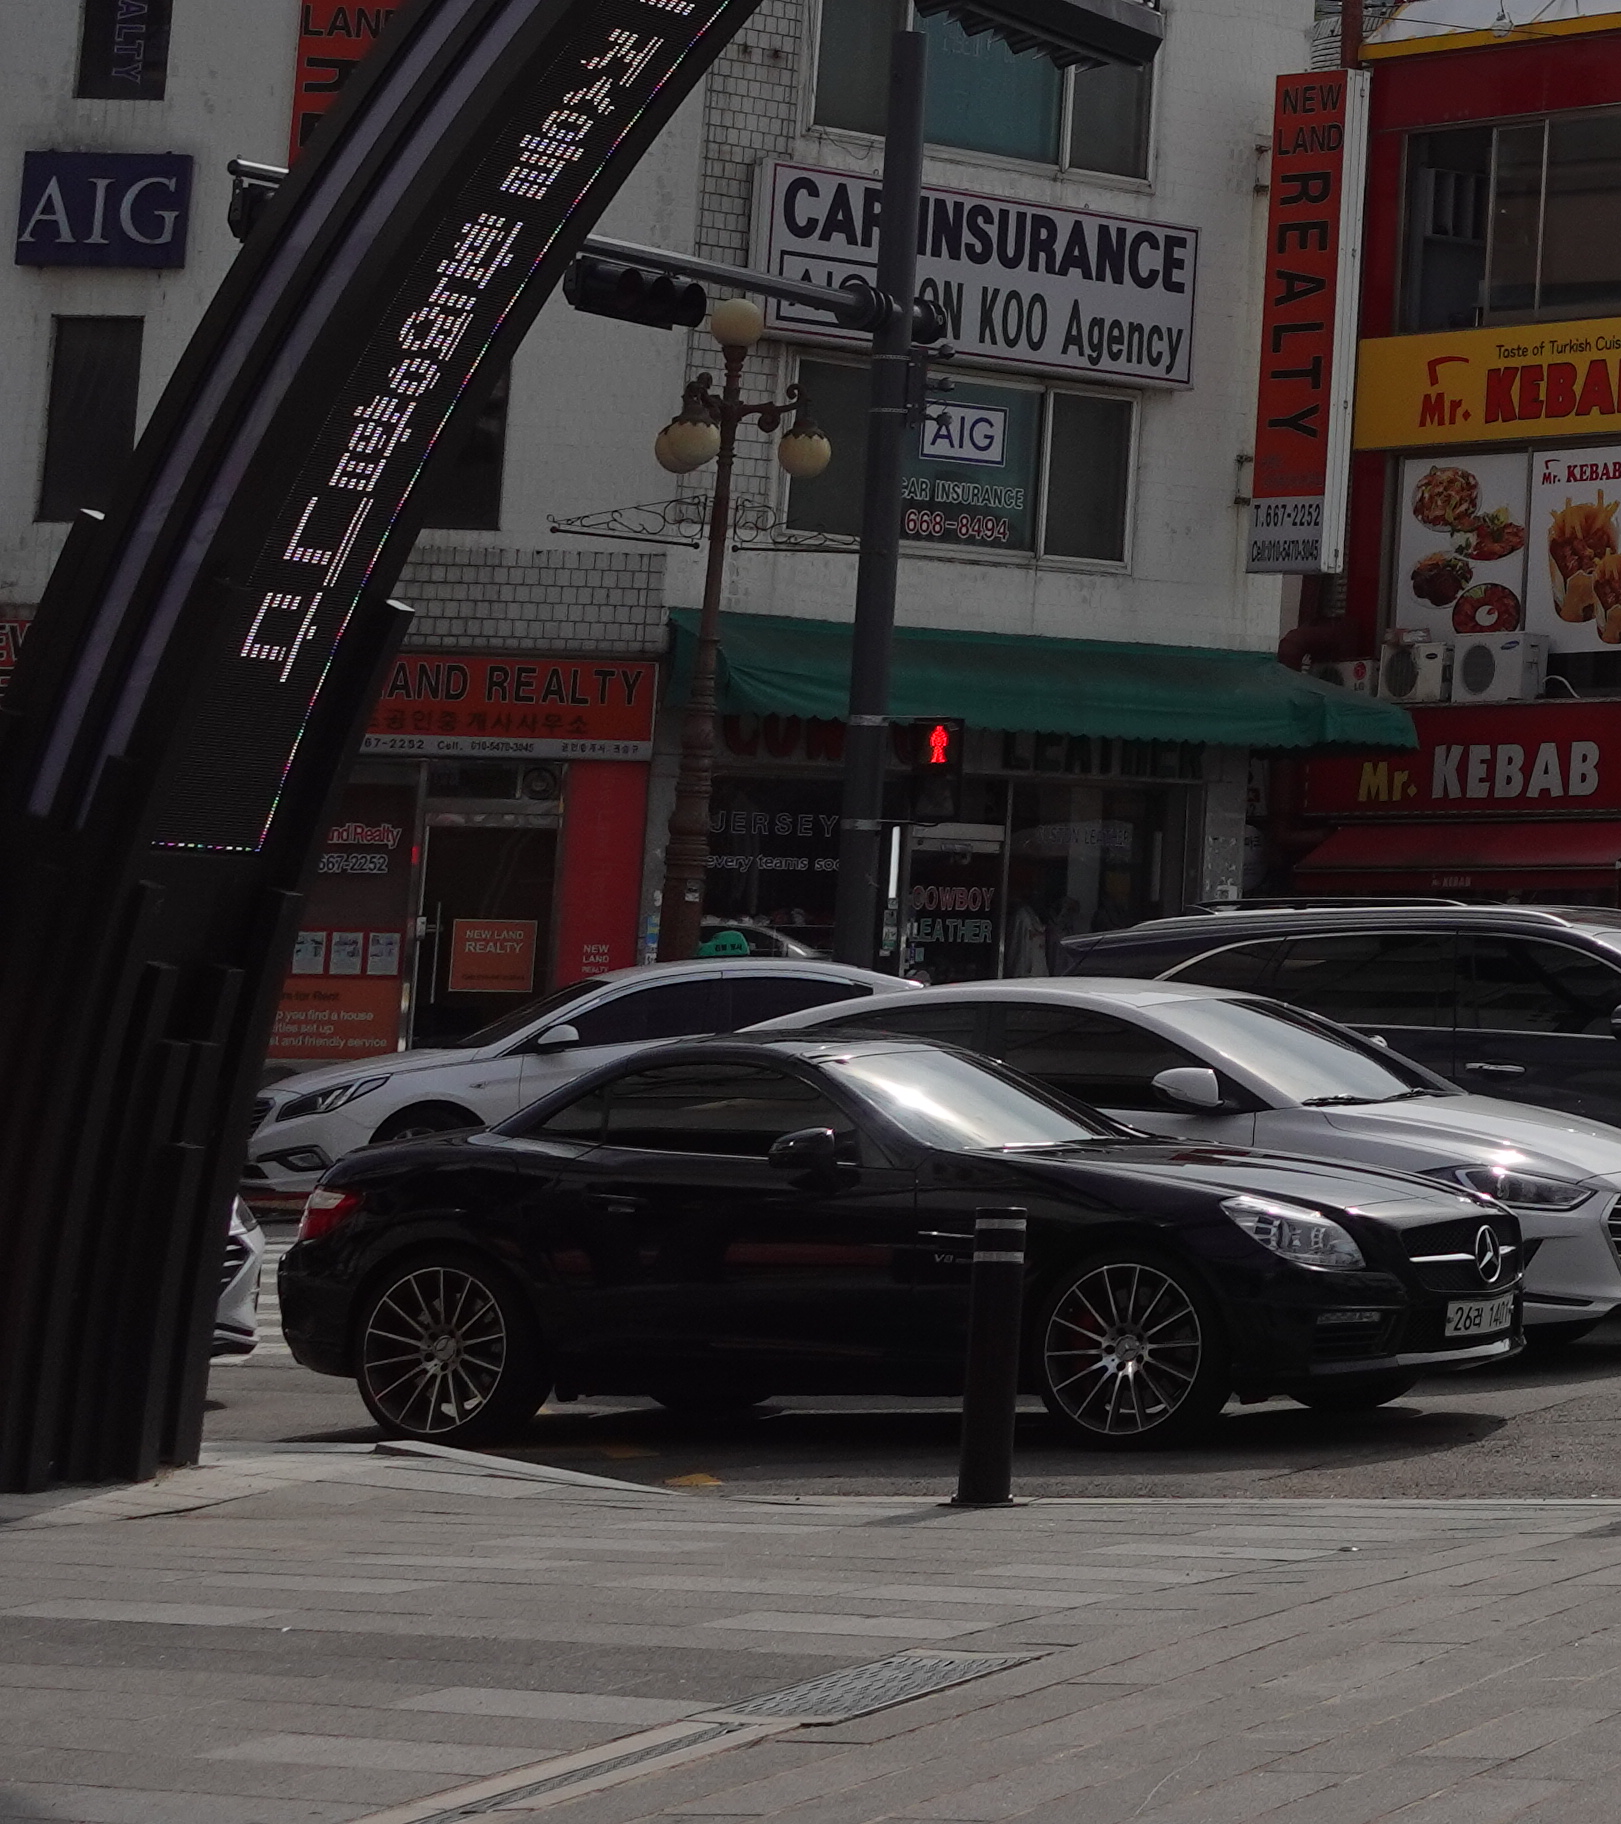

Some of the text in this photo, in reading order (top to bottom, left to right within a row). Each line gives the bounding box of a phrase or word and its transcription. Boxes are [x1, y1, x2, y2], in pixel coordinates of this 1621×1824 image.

[500, 28, 664, 199] 것을
[1283, 83, 1343, 115] NEW
[1278, 122, 1344, 156] LAND
[18, 175, 180, 246] AIG
[917, 195, 1187, 294] INSURANCE
[1267, 171, 1332, 439] REALTY
[979, 286, 1048, 351] KOO
[1061, 299, 1183, 375] Agency
[1495, 343, 1530, 361] Taste
[1531, 341, 1546, 356] of
[1549, 335, 1592, 354] Turkish
[1418, 392, 1472, 428] Mr.
[240, 212, 523, 683] 환영합니다
[930, 416, 995, 452] AIG
[1541, 470, 1562, 485] Mr.
[935, 479, 1024, 510] INSURANCE
[905, 508, 1010, 542] 668-8494
[380, 661, 644, 707] AND REALTY
[369, 708, 588, 734] 공인중개사사무소
[1357, 741, 1600, 802] Mr. KEBAB
[352, 823, 402, 849] Realty
[710, 810, 840, 838] JERSEY
[706, 855, 753, 873] every
[756, 854, 809, 870] teams
[912, 885, 995, 911] COWBOY
[465, 929, 524, 940] NEW LAND
[907, 918, 992, 943] LEATHER
[464, 941, 524, 954] REALTY
[582, 955, 610, 964] LAND
[583, 944, 610, 954] NEW
[340, 1010, 374, 1021] house
[304, 1035, 345, 1049] friendly
[347, 1037, 387, 1047] service
